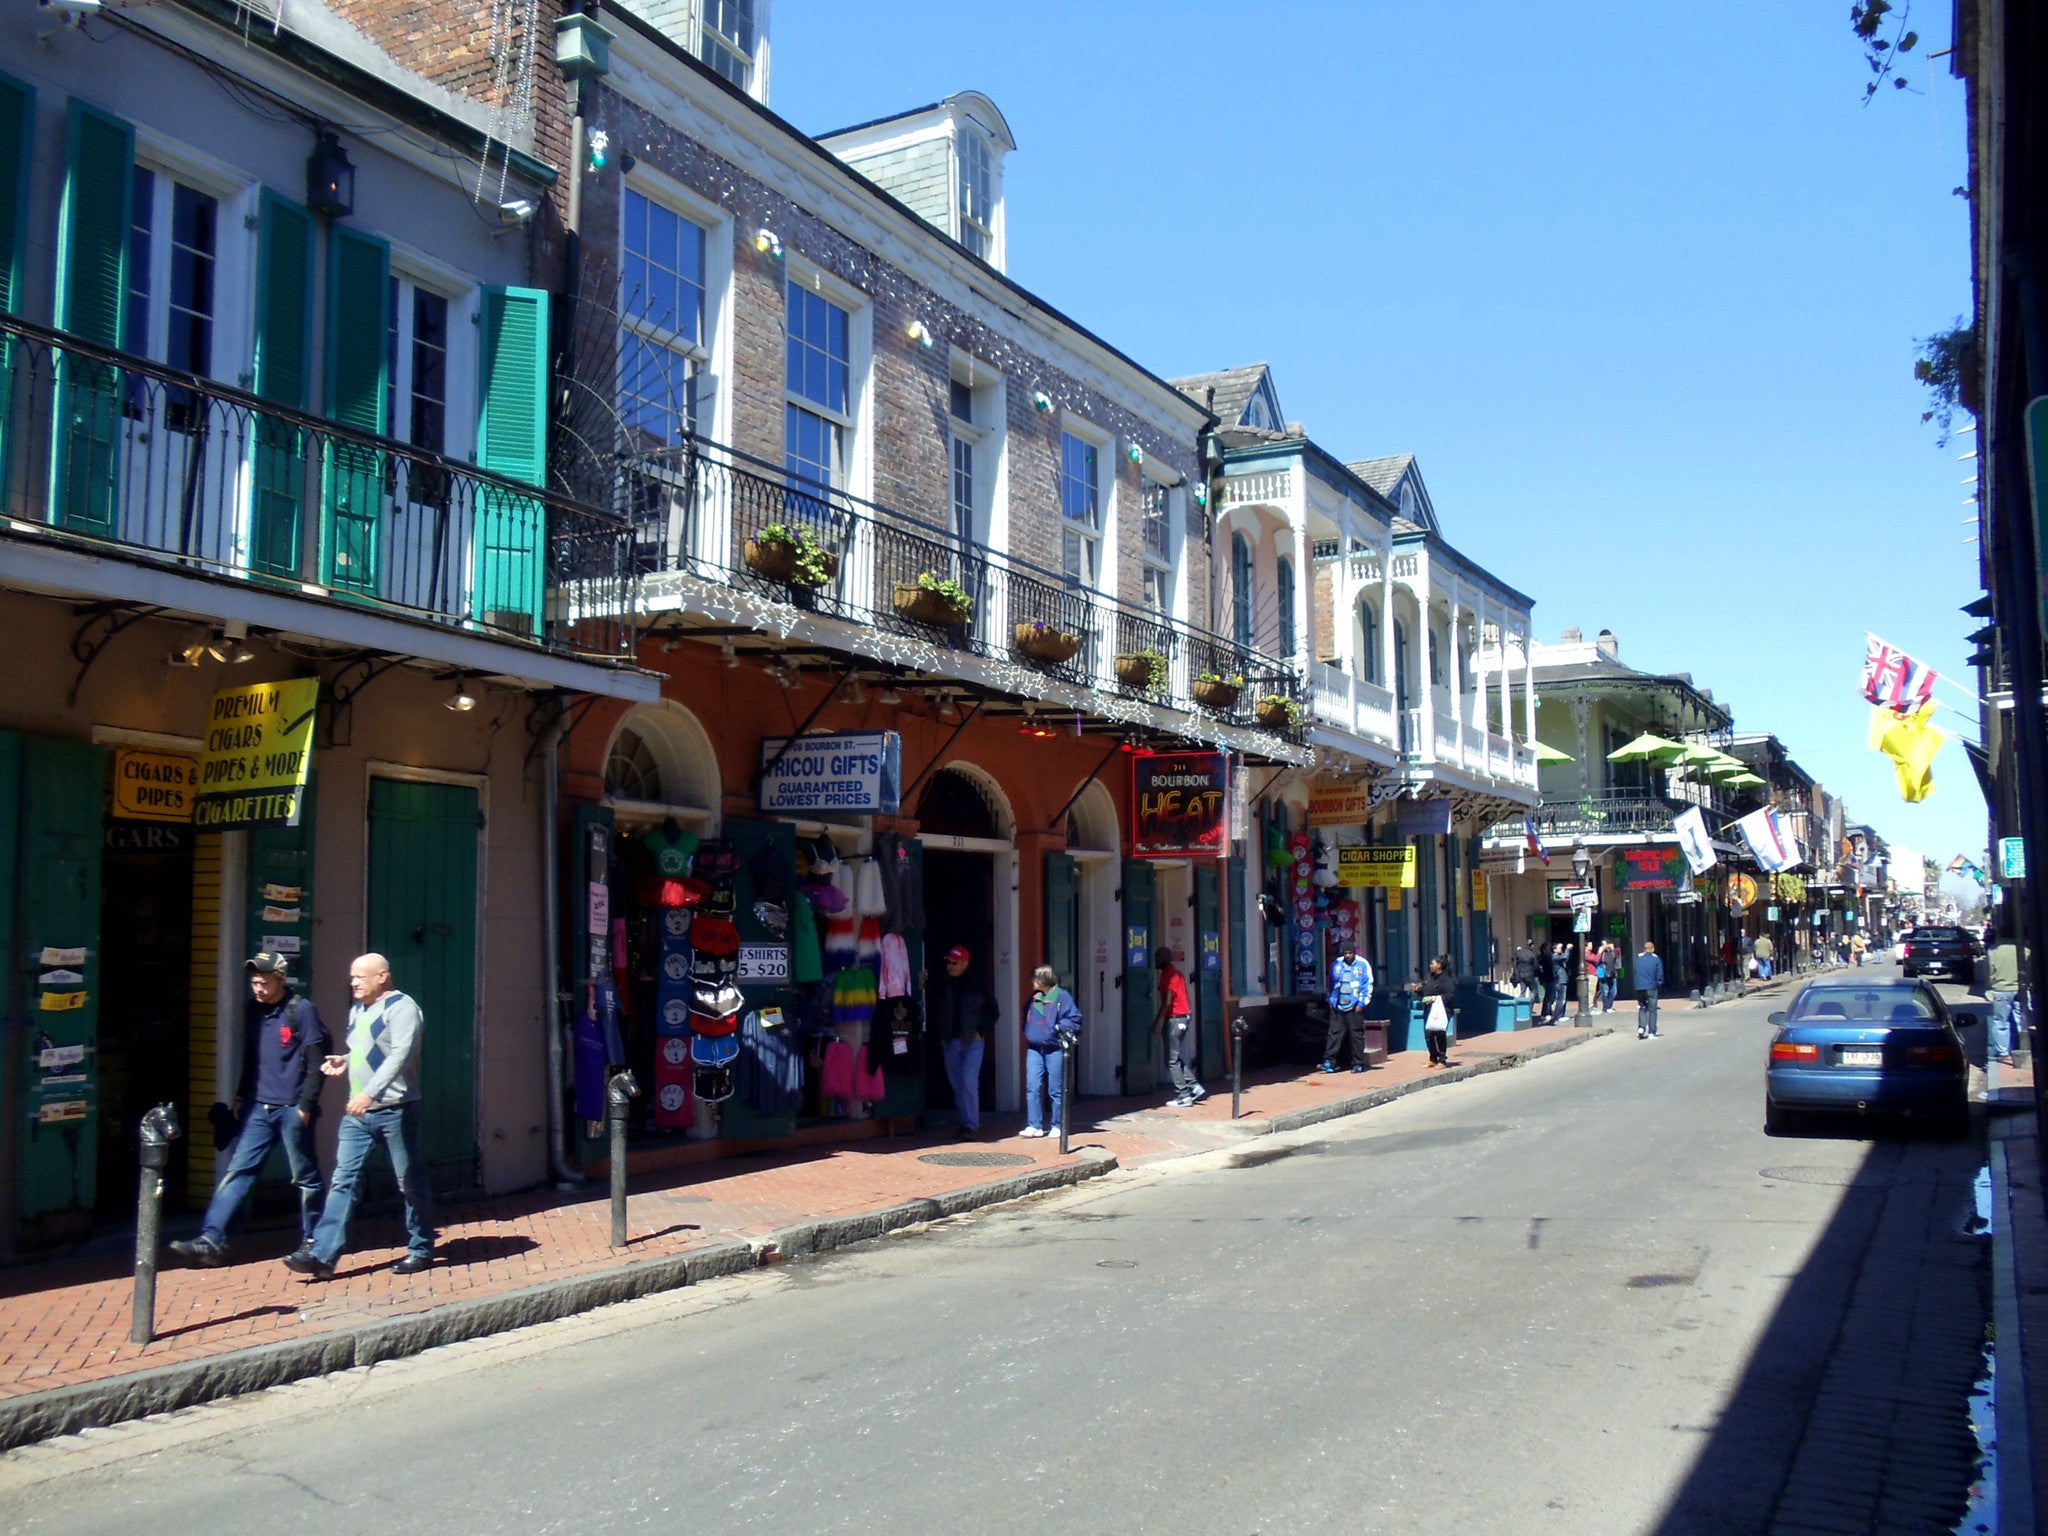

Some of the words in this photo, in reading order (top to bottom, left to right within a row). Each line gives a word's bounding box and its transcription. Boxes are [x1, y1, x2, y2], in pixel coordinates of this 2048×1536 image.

[213, 690, 280, 720] PREMIUM
[209, 723, 263, 752] CIGARS
[805, 741, 842, 751] BOURBON
[124, 761, 184, 784] CIGARS
[188, 768, 197, 785] &
[203, 757, 246, 784] PIPES
[250, 756, 260, 779] &
[265, 750, 305, 777] MORE
[765, 756, 825, 777] TRICOU
[831, 754, 879, 775] GIFTS
[778, 780, 863, 794] GUARANTEED
[1151, 775, 1210, 787] BOURBON
[137, 787, 184, 808] PIPES
[769, 794, 820, 806] LOWEST
[824, 793, 871, 805] PRICES
[1141, 791, 1222, 820] HEAT
[1309, 798, 1343, 813] BOURBON
[1346, 796, 1366, 811] GIFTS
[195, 794, 296, 826] CIGARETTES
[104, 827, 179, 848] GARS
[1341, 851, 1370, 861] CIGAR
[1373, 850, 1412, 861] SHOPPE
[738, 949, 787, 960] T-SHIRTS
[739, 963, 749, 976] 5
[757, 963, 786, 977] $20
